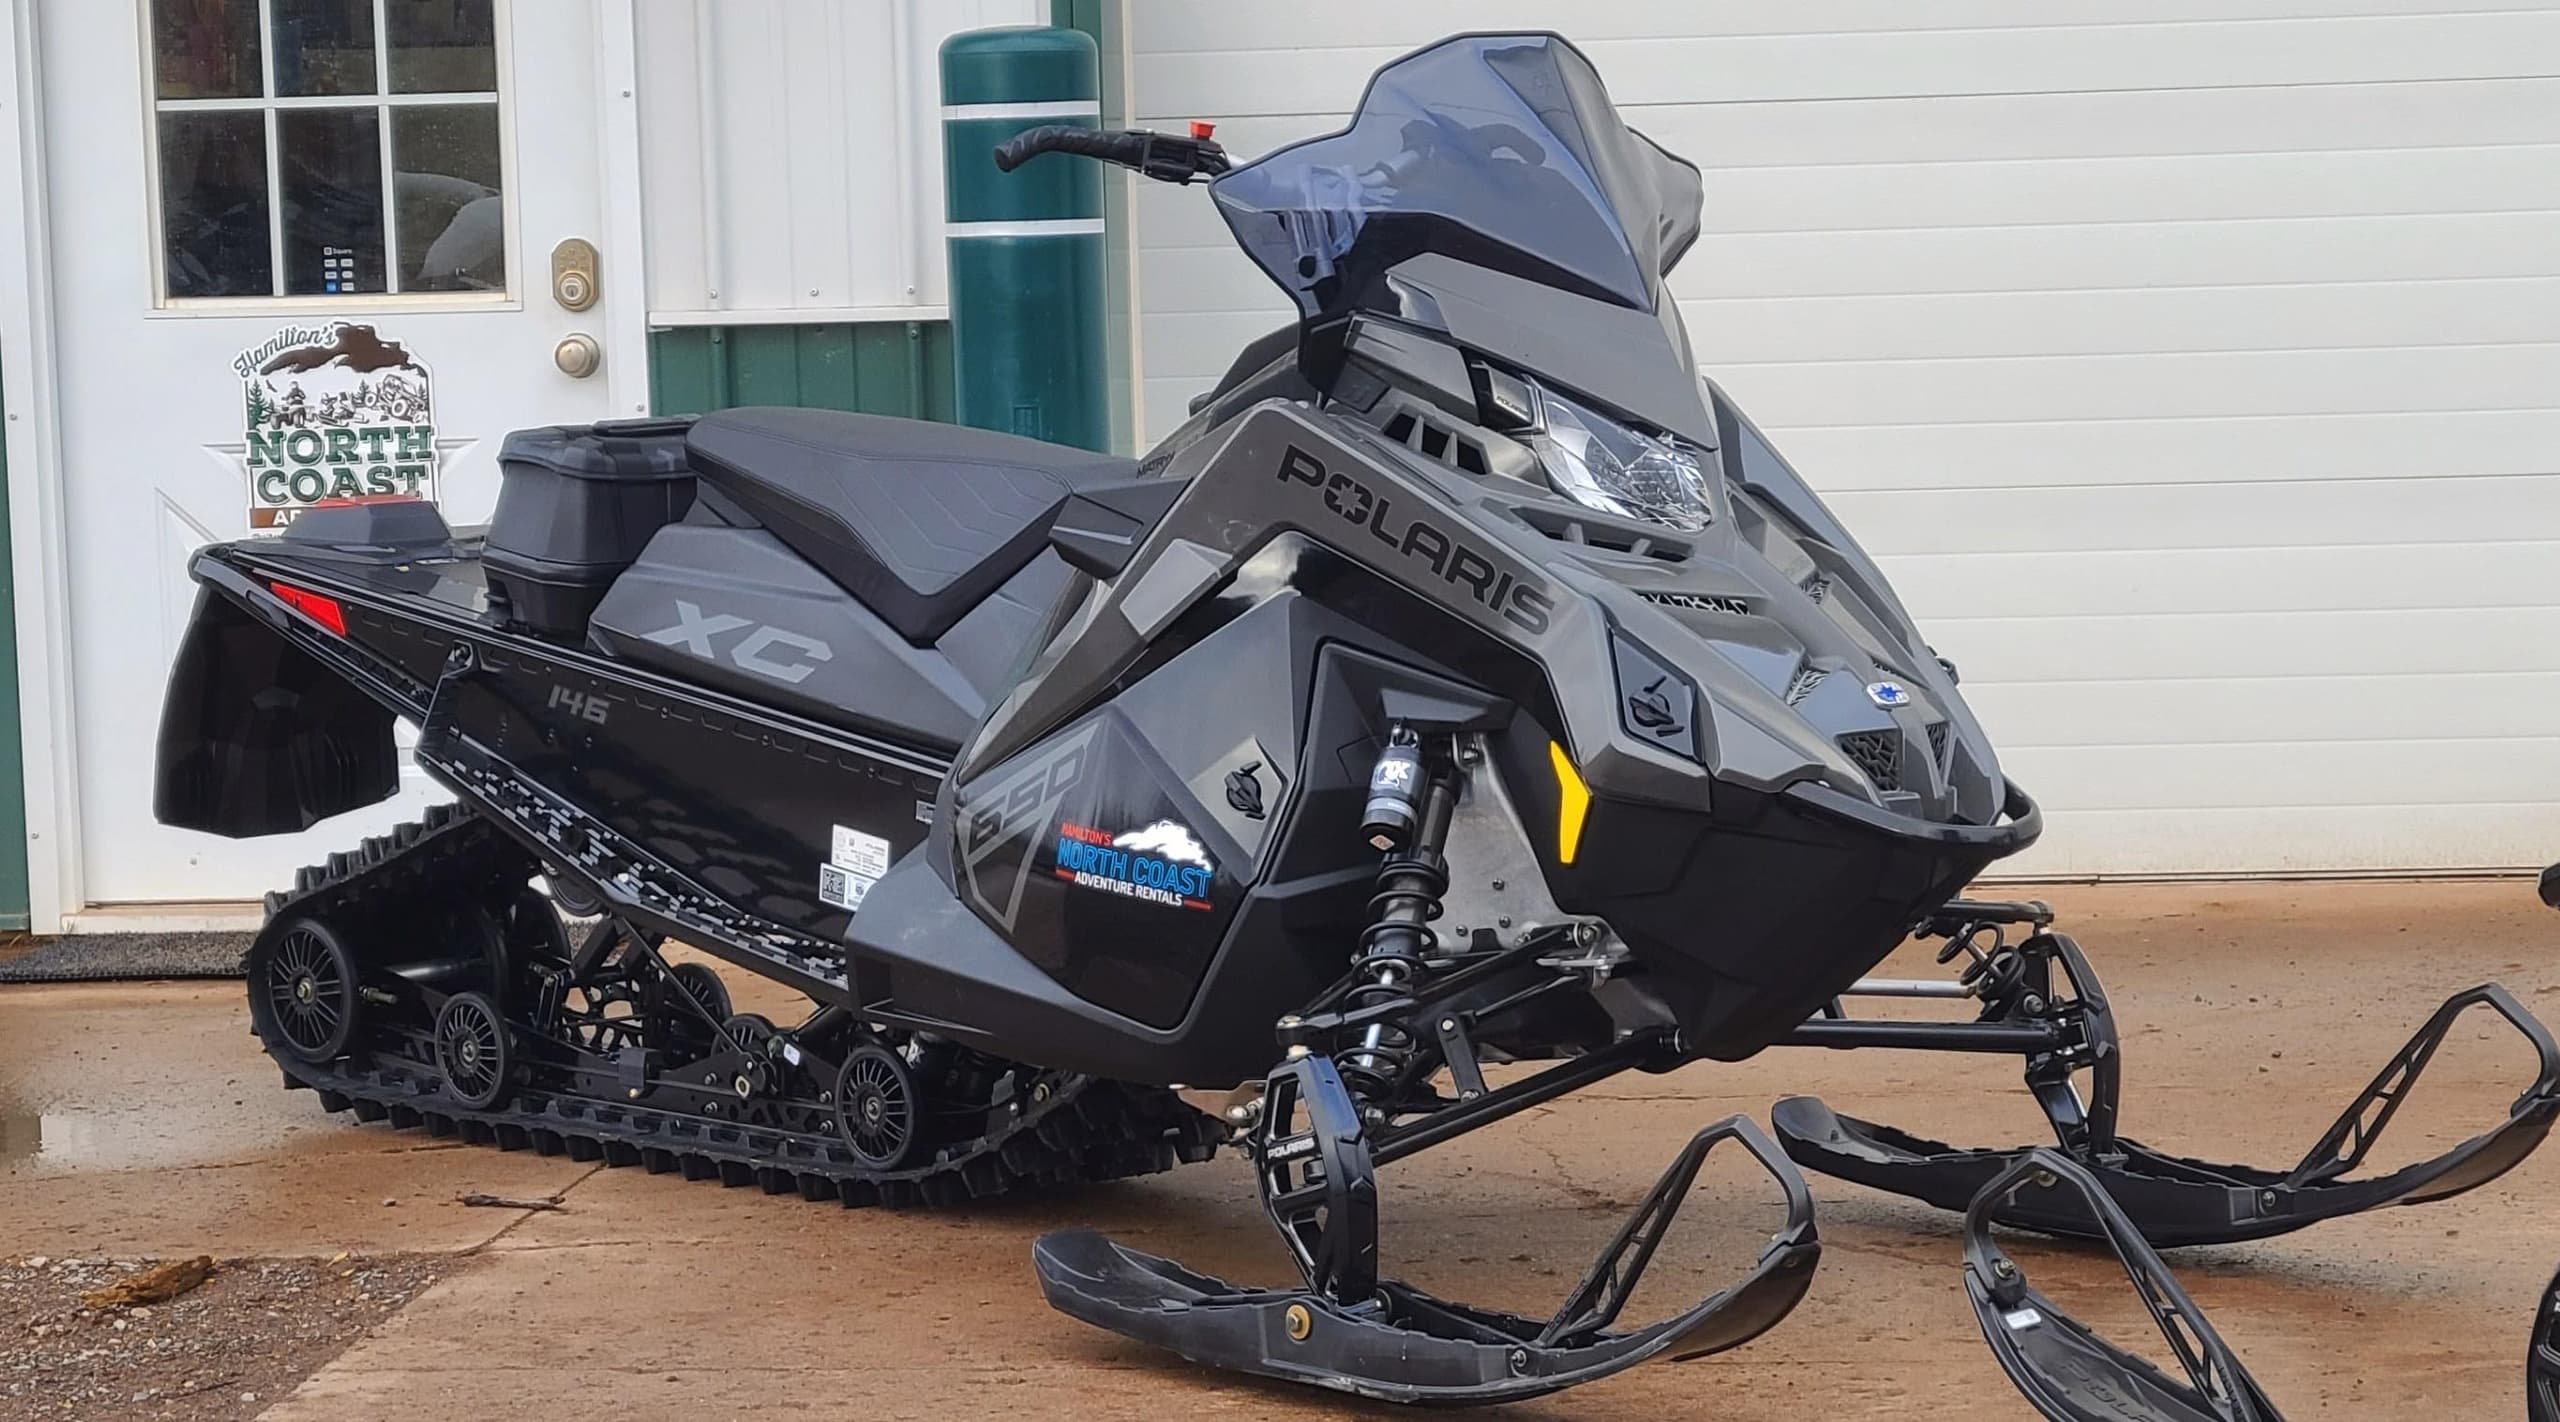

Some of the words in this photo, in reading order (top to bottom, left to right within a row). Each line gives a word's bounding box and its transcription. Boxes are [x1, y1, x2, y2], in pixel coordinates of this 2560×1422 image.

[233, 326, 336, 378] Hamilton's
[246, 425, 434, 466] NORTH
[257, 465, 429, 504] COAST
[1277, 444, 1555, 635] POLARIS
[640, 600, 833, 683] XC
[548, 685, 610, 725] 146
[968, 744, 1087, 856] 650
[1060, 822, 1113, 847] HAMILTON'S
[1057, 838, 1128, 880] NORTH
[1132, 857, 1212, 898] COAST
[1074, 871, 1134, 896] ADVENTURE
[1135, 887, 1183, 906] RENTALS
[1267, 1137, 1315, 1159] POLARIS
